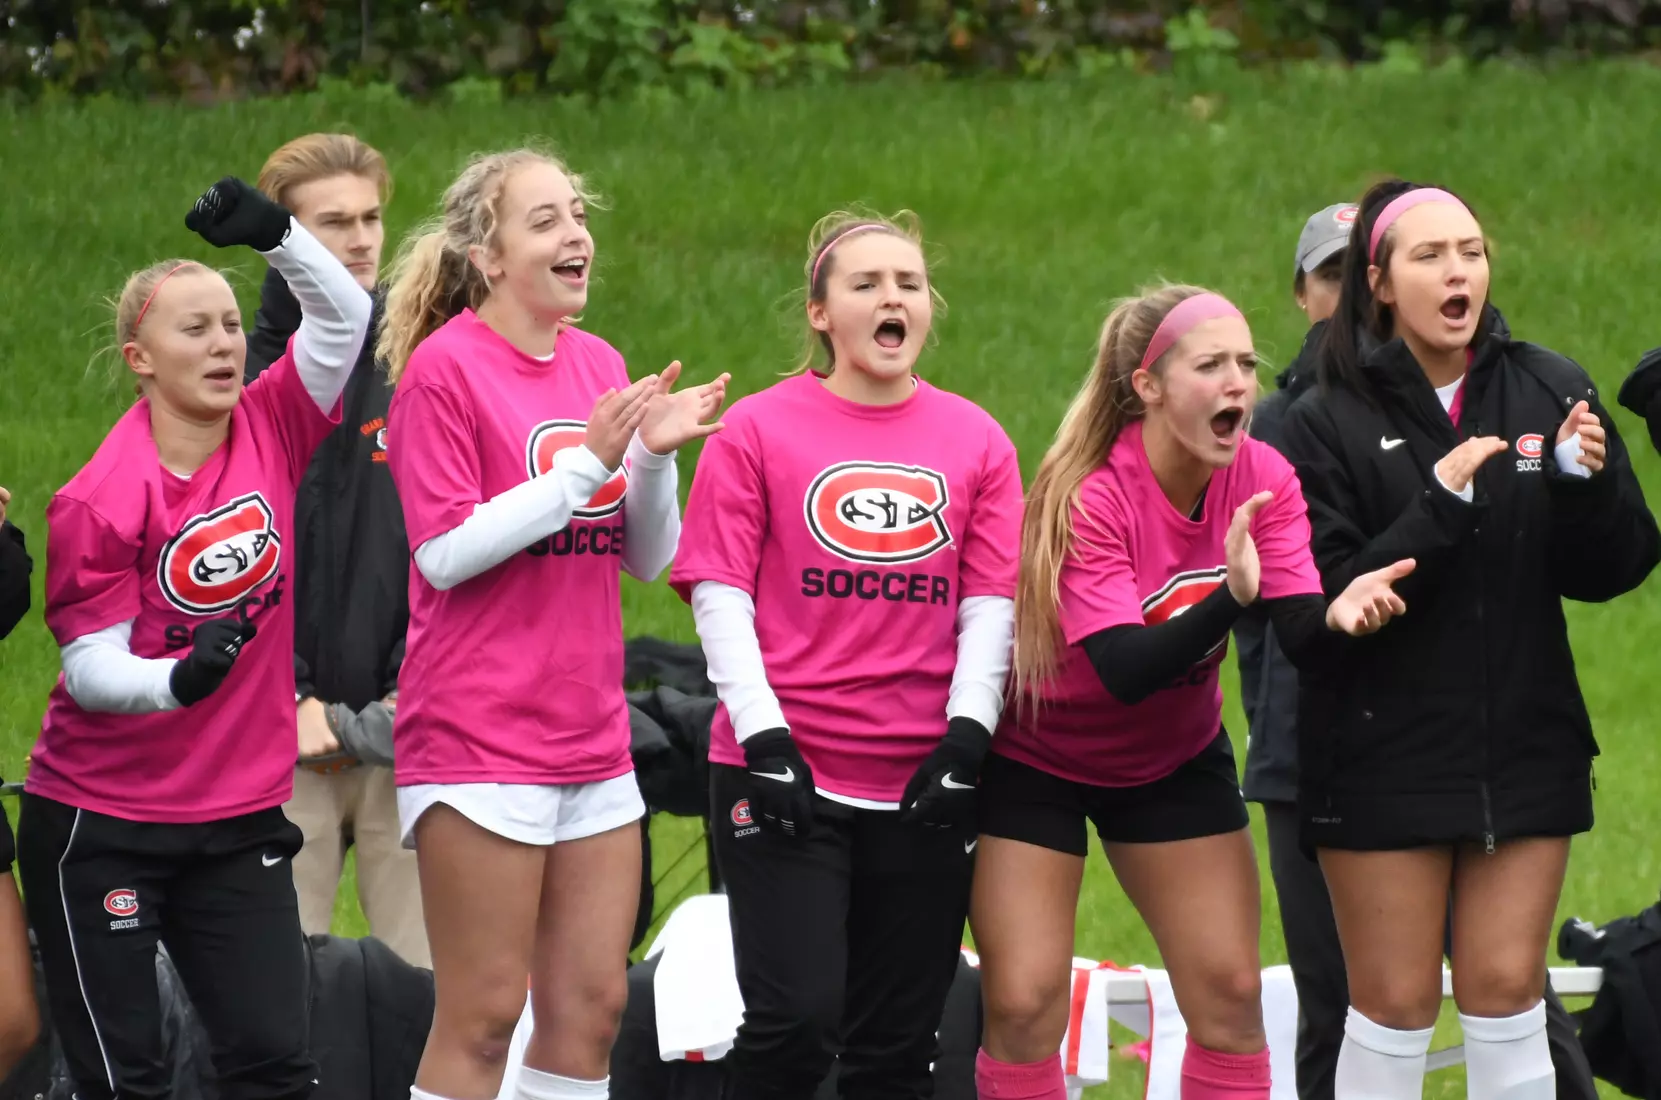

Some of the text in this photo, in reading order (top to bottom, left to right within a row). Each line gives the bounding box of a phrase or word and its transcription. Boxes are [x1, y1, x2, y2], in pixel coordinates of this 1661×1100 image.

[1516, 459, 1542, 471] SOCC
[525, 525, 625, 557] SOCCE
[801, 567, 950, 606] SOCCER
[734, 826, 760, 838] SOCCER
[110, 918, 139, 930] SOCCER
